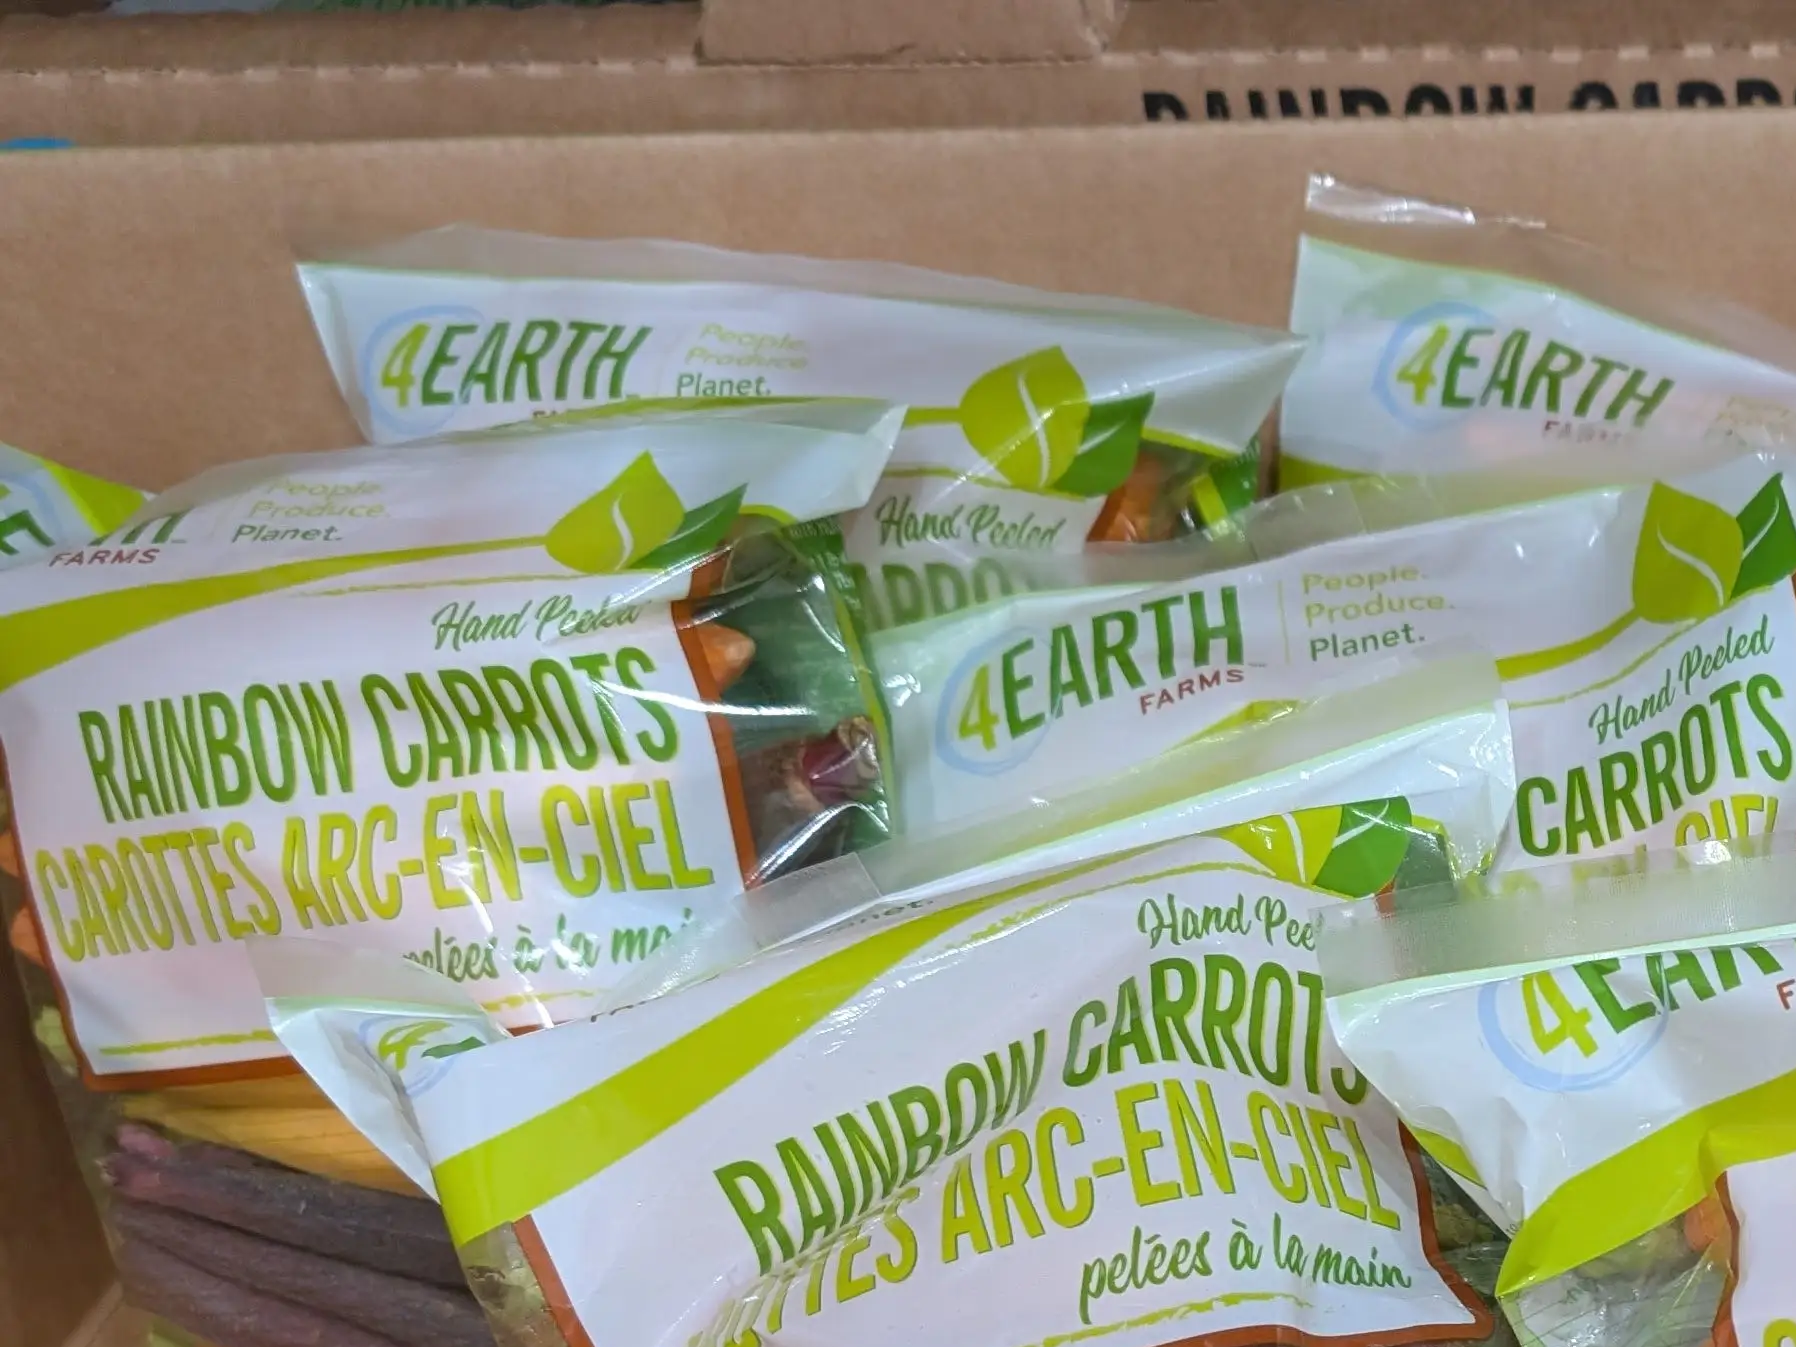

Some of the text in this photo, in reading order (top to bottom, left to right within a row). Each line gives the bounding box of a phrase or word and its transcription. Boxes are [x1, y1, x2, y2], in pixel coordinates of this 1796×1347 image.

[380, 320, 654, 408] 4EARTH
[677, 372, 771, 398] Planet.
[1396, 321, 1676, 428] 4EARTH
[48, 548, 161, 568] FARMS
[231, 523, 343, 543] Planet.
[875, 495, 960, 549] Hand
[1302, 565, 1428, 595] People.
[1304, 590, 1455, 628] Produce.
[431, 600, 534, 652] Hand
[1309, 622, 1425, 661] Planet.
[958, 585, 1244, 752] 4EARTH
[1139, 668, 1245, 715] FARMS
[1588, 614, 1775, 746] Hand Peeled
[79, 646, 680, 825] RAINBOW CARROTS
[1516, 672, 1795, 858] CARROTS
[34, 779, 715, 962] CAROTTES ARC-EN-CIEL
[1136, 893, 1252, 949] Hand
[712, 1029, 1046, 1277] RAINBOW
[940, 1077, 1402, 1264] ARC-EN-CIEL
[1079, 1212, 1413, 1325] pelées à la main
